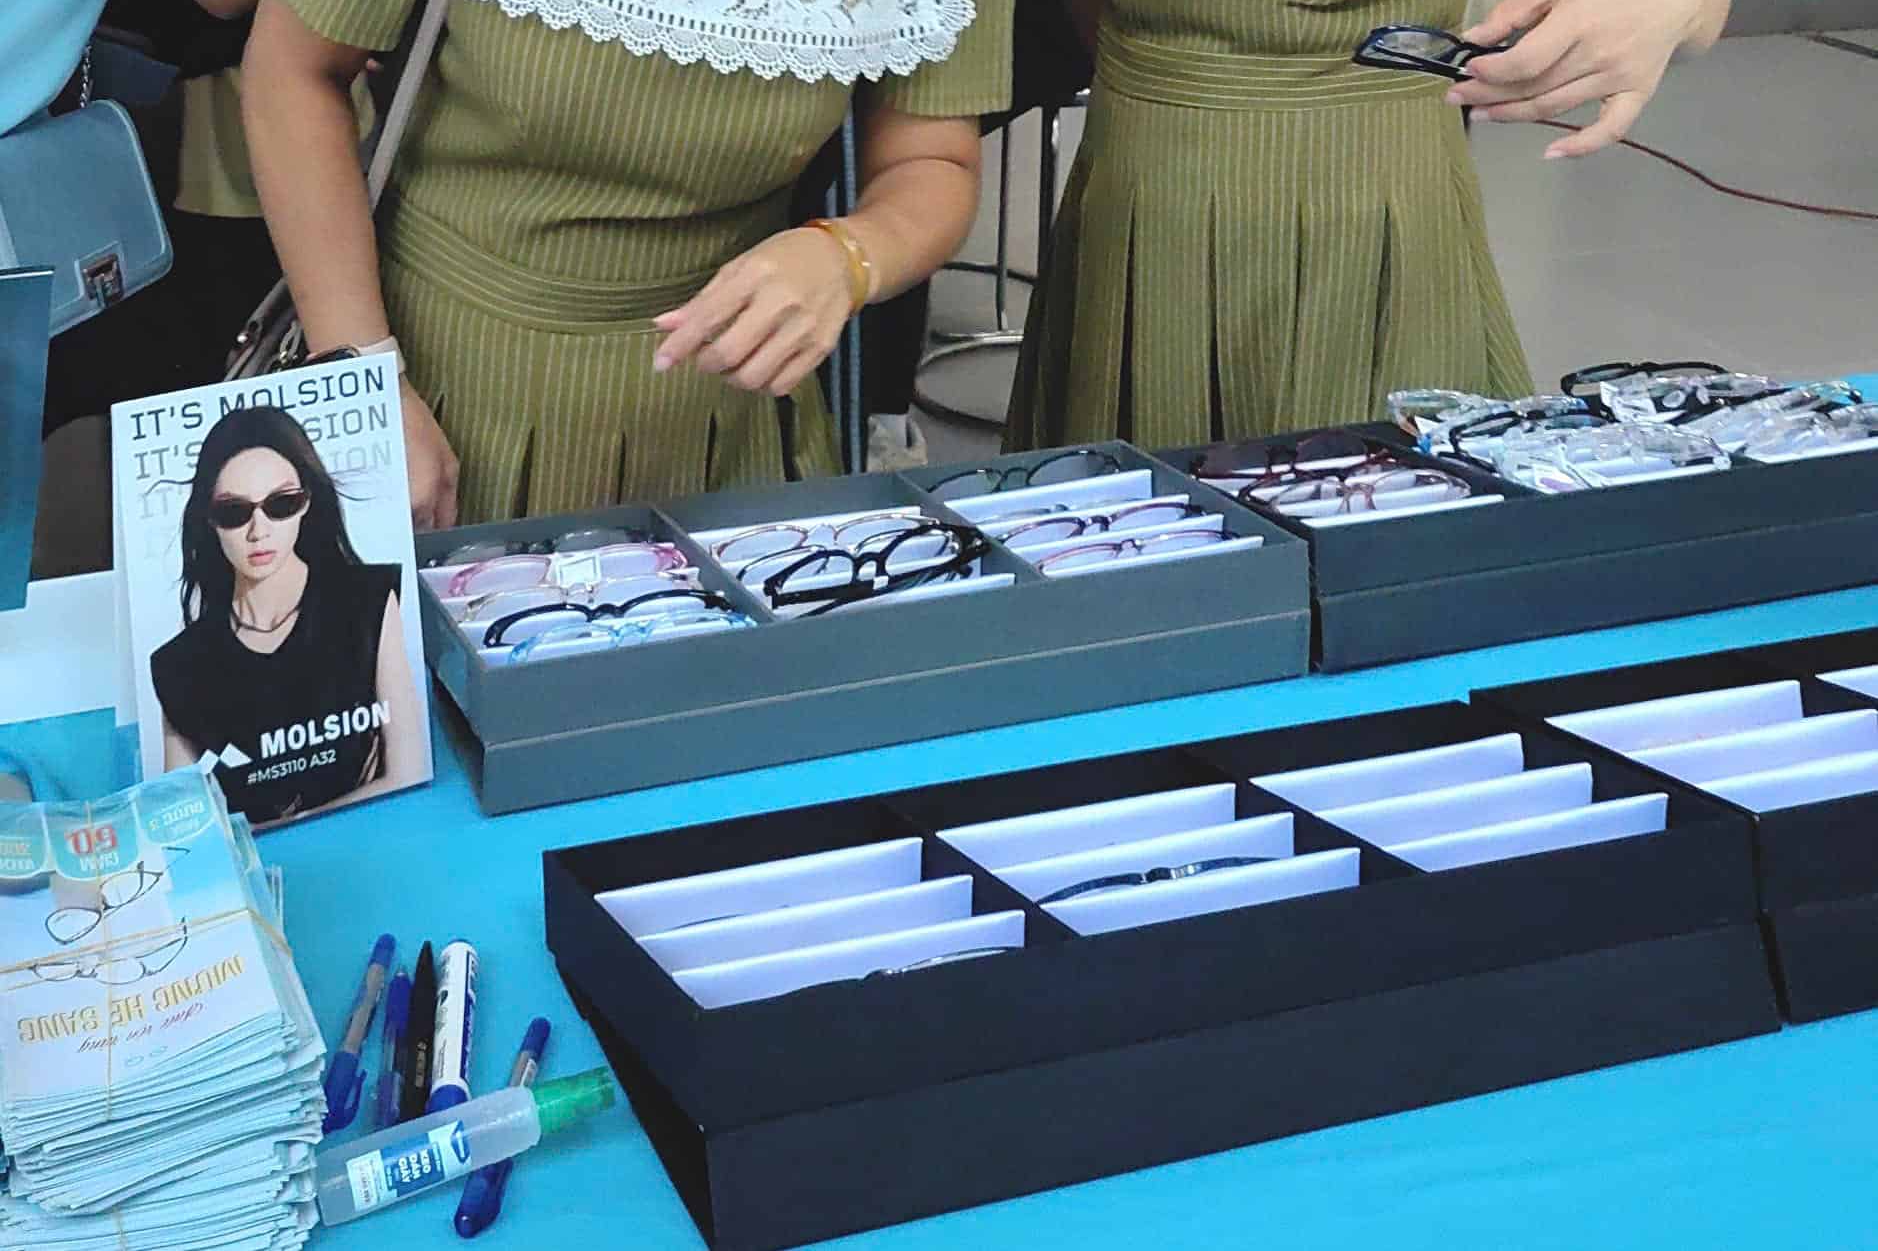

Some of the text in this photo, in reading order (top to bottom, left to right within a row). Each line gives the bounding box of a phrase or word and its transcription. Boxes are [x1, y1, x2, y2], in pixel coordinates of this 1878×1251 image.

[130, 401, 203, 440] IT'S
[303, 402, 389, 443] SION
[260, 700, 391, 759] MOLSION
[247, 749, 337, 785] #MS3110 A32
